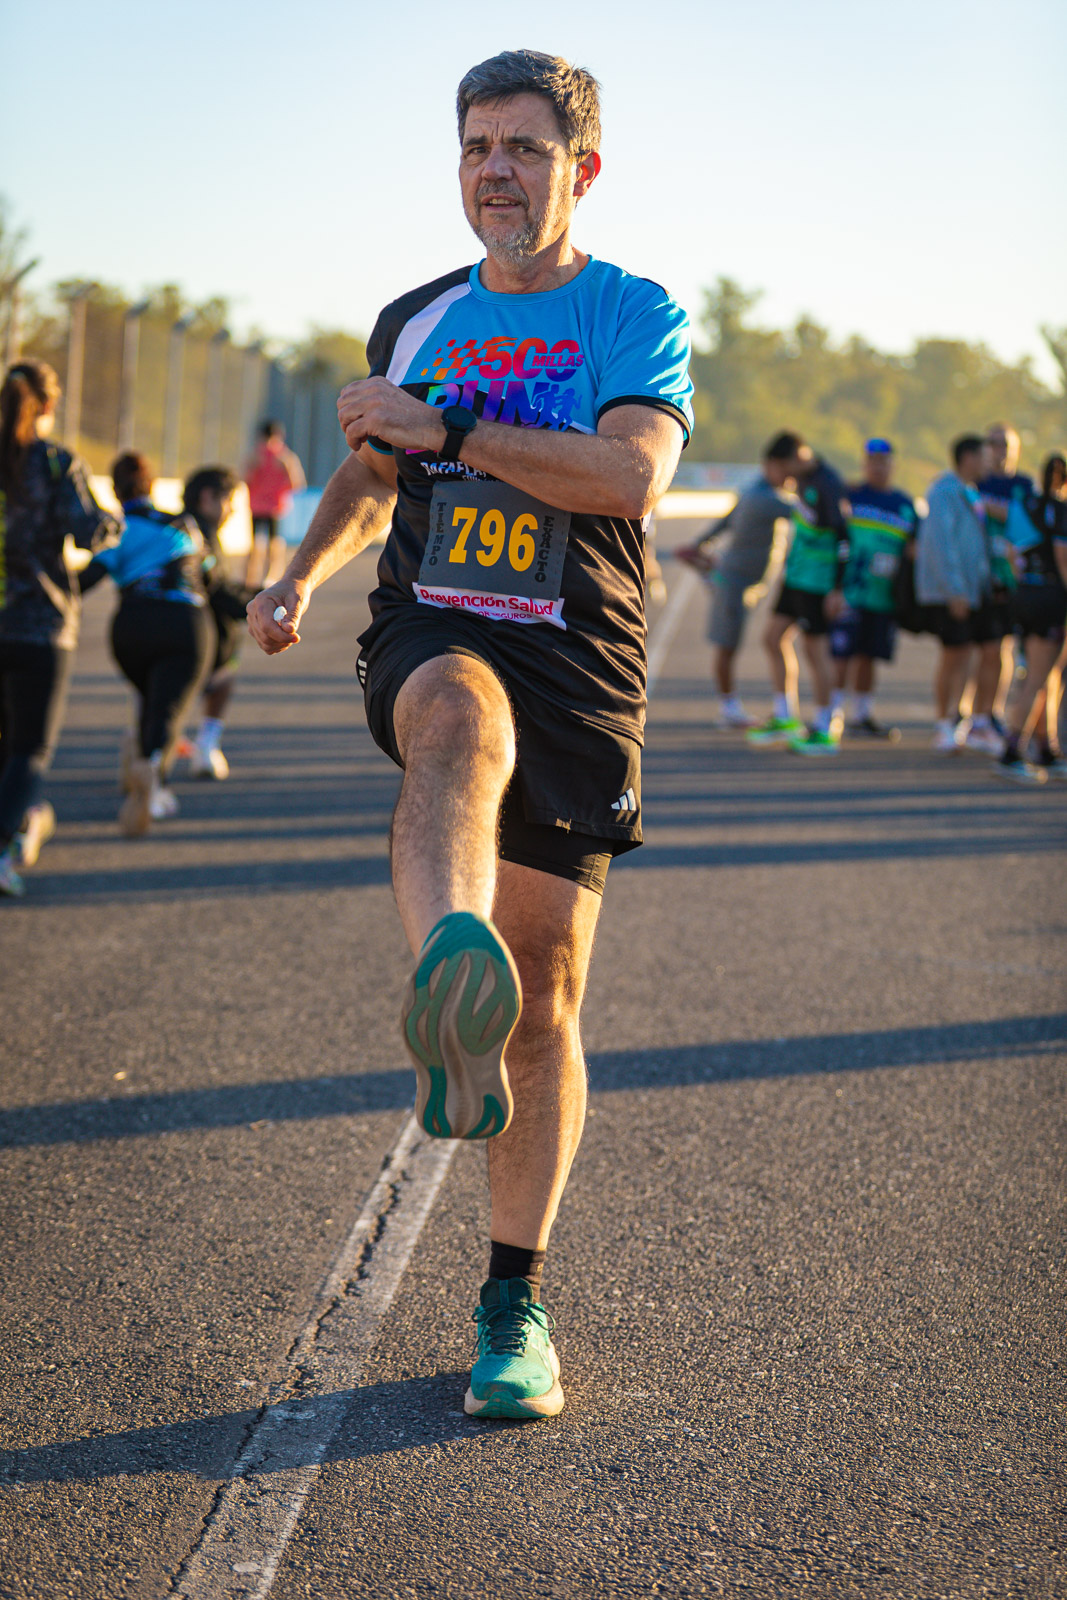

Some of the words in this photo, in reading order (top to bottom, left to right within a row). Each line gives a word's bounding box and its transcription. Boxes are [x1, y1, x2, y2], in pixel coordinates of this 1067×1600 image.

[532, 354, 584, 367] MILLAS
[429, 502, 446, 566] TIEMPO
[449, 507, 538, 572] 796
[535, 516, 554, 583] EXACTO
[420, 589, 506, 609] Prevención
[509, 597, 554, 615] Salud
